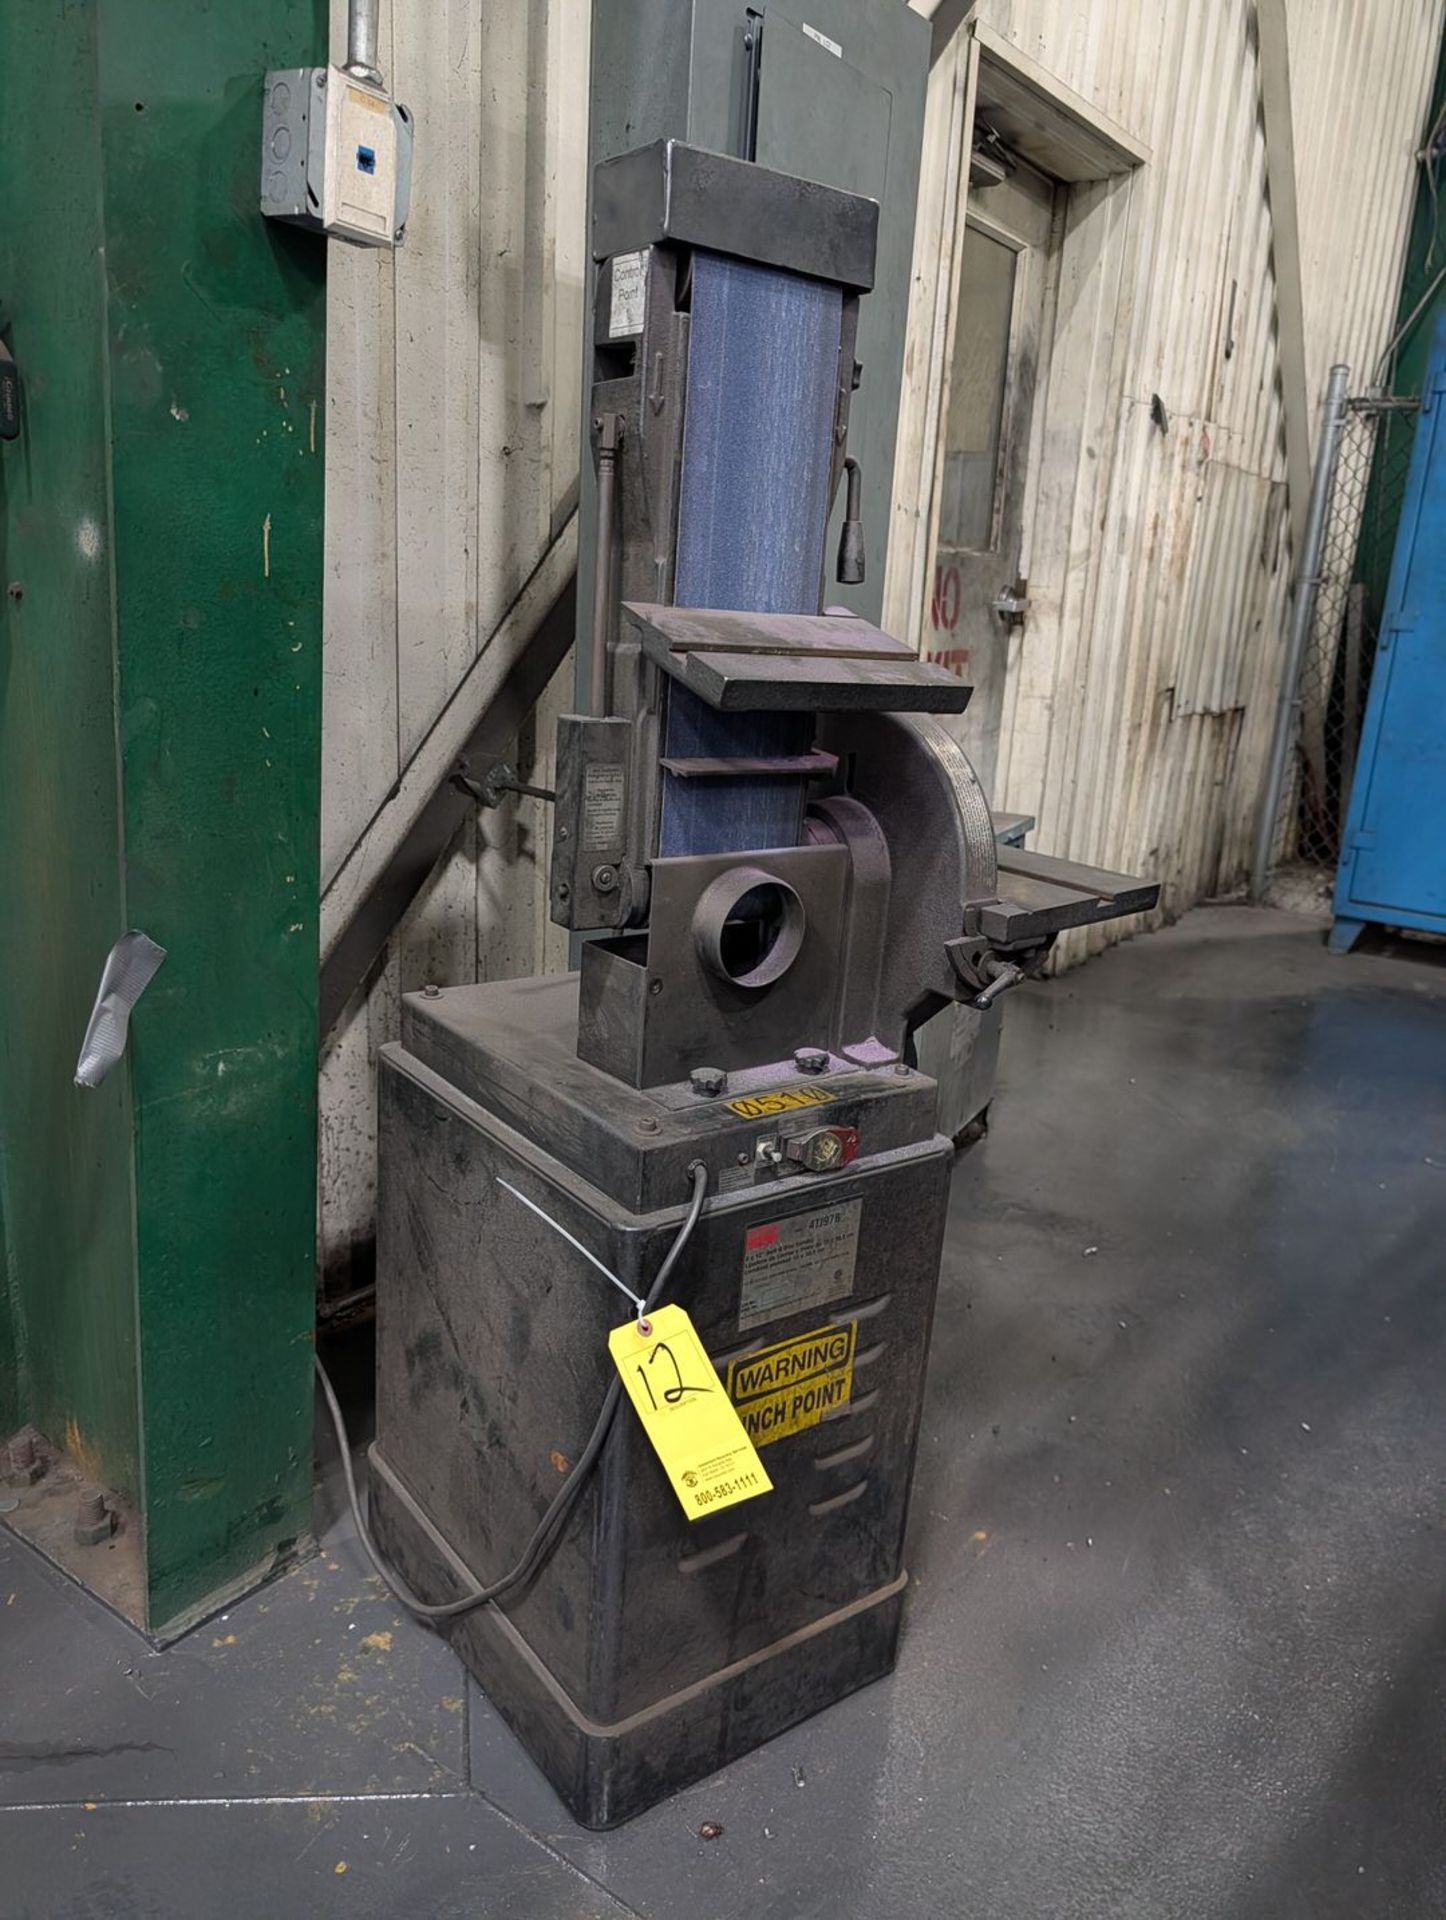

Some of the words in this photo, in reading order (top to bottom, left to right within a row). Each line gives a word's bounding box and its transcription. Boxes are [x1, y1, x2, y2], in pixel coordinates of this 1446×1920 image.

[635, 1342, 715, 1411] 12
[739, 1336, 846, 1393] WARNING
[740, 1401, 787, 1437] INCH
[791, 1378, 846, 1419] POINT
[694, 1471, 759, 1507] 800-583-1111
